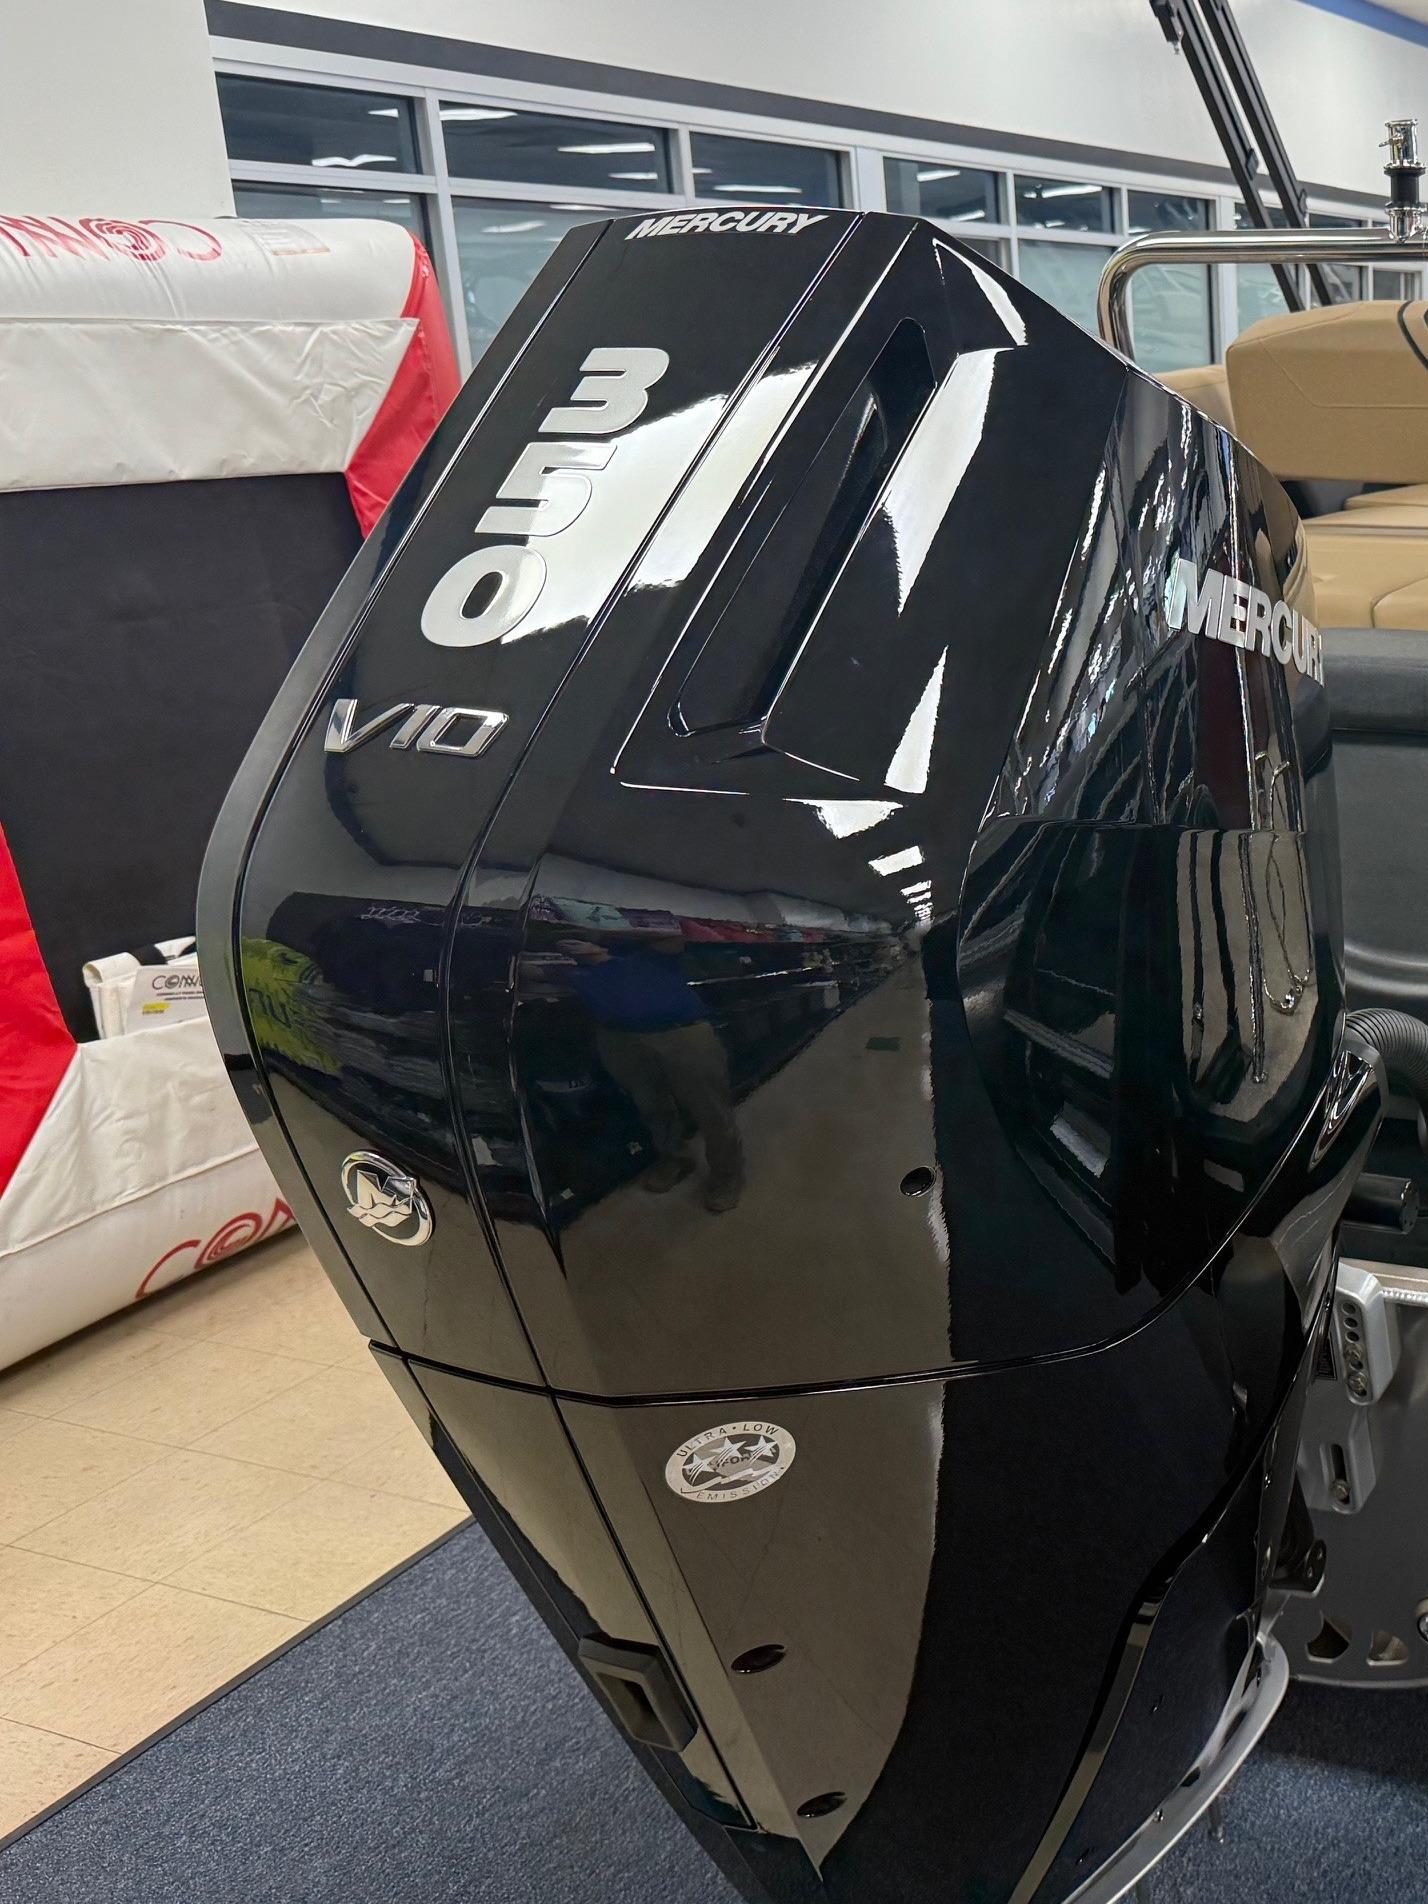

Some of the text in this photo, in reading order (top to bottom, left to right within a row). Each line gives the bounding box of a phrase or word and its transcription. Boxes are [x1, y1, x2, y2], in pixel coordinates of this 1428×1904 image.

[624, 211, 829, 240] MERCURY
[420, 347, 670, 648] 350
[1165, 557, 1325, 688] MERCUR
[323, 698, 509, 758] V10
[677, 1423, 779, 1458] ULTRA LOW
[696, 1470, 781, 1500] EMISSION
